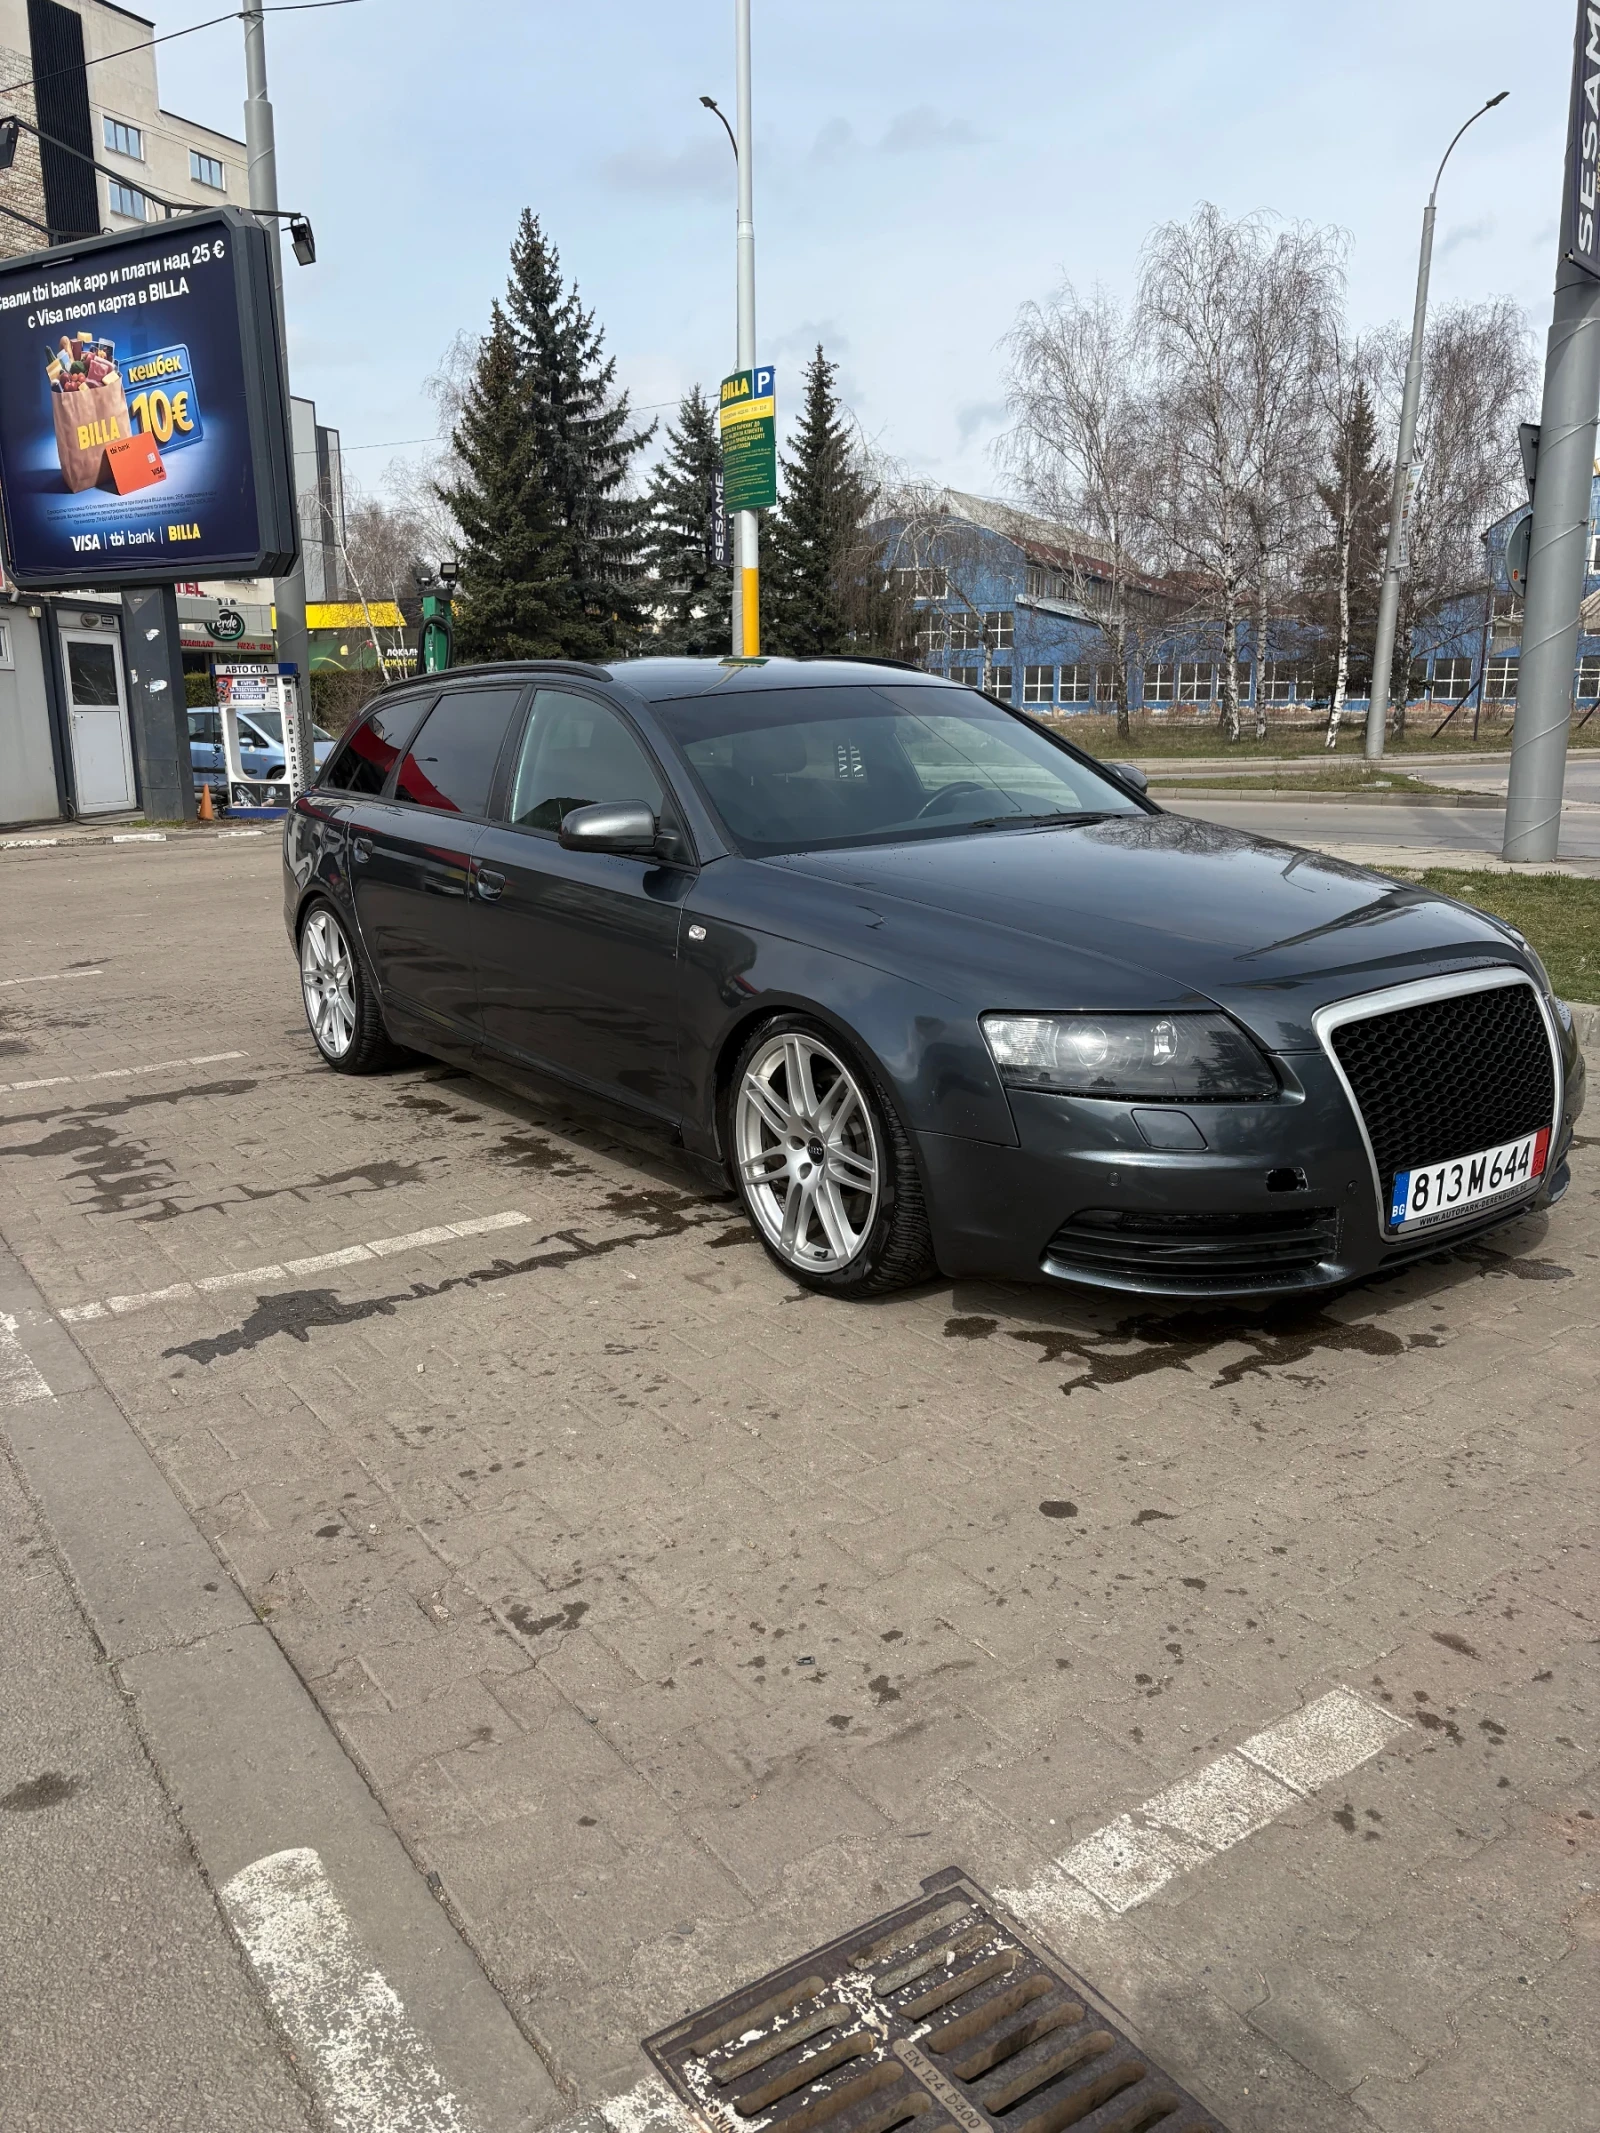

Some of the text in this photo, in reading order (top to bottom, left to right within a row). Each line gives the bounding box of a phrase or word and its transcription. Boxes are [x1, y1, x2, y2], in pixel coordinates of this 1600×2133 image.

[1578, 0, 1600, 255] SESAM
[32, 283, 49, 302] tbi
[51, 276, 82, 298] bank
[84, 272, 108, 292] app
[110, 269, 119, 284] и
[121, 260, 161, 280] плати
[163, 253, 191, 271] над
[191, 244, 210, 264] 25
[212, 239, 225, 259] €
[28, 277, 189, 328] с Visa neon карта в BILLA
[128, 354, 182, 383] кешбек
[757, 371, 770, 393] P
[722, 378, 749, 402] BILLA
[77, 416, 121, 450] BILLA
[118, 443, 130, 452] bank
[151, 466, 164, 475] VISA
[715, 473, 724, 560] SESAME
[70, 523, 201, 551] VISA tbi bank BILLA
[225, 665, 269, 674] АВТО СПА
[287, 719, 301, 797] АВТОПАРФЮ
[837, 745, 848, 773] VIP
[850, 745, 862, 773] VIP
[1392, 1203, 1405, 1217] BG
[1419, 1183, 1527, 1226] WWW.AUTOPARK-DERENBURG.DE
[903, 2049, 980, 2129] EN 124 D400
